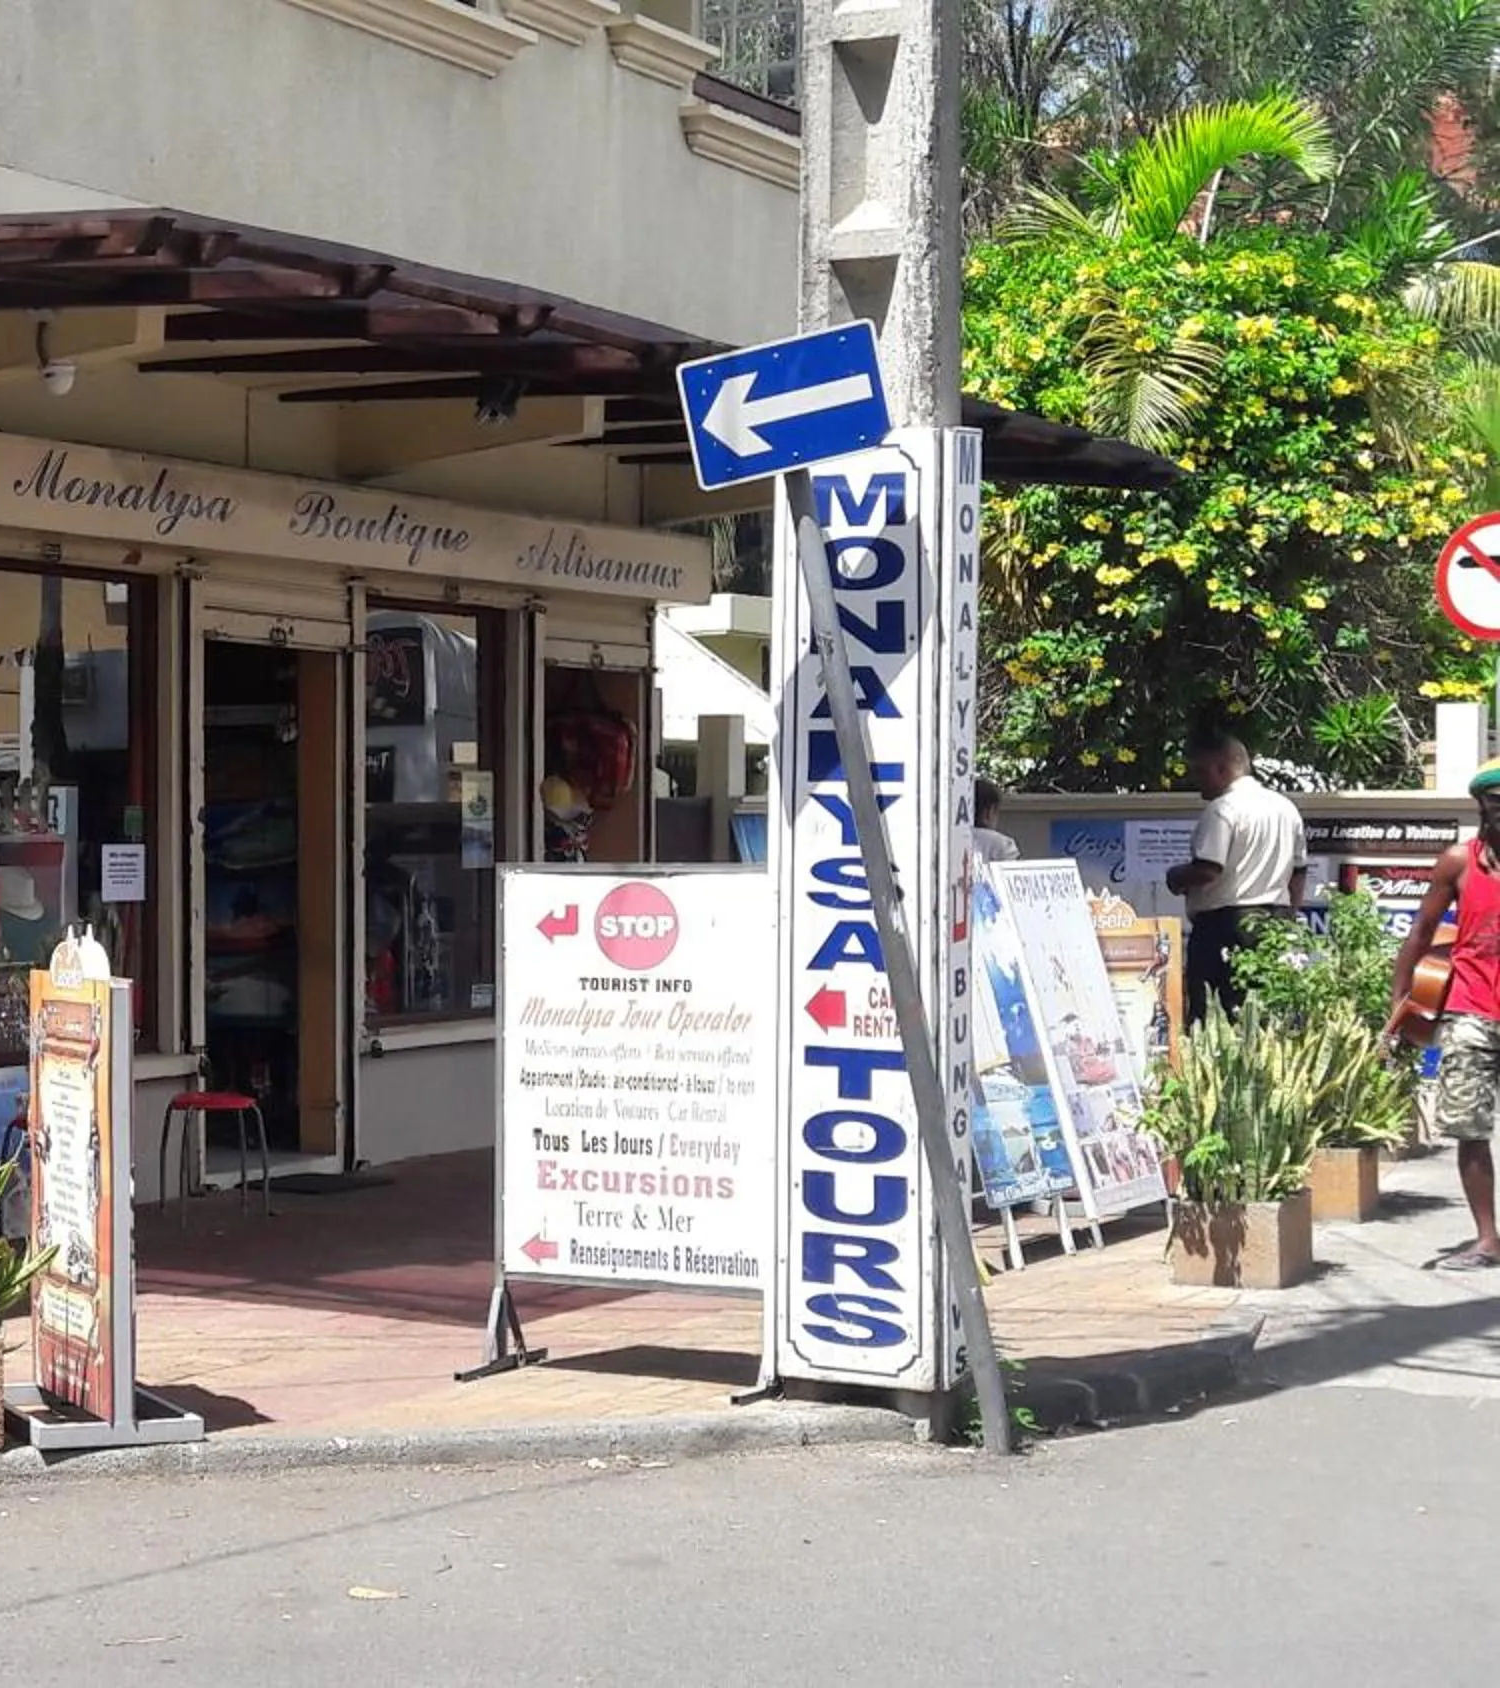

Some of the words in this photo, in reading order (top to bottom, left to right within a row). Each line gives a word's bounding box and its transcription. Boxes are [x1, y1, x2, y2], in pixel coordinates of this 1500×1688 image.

[13, 449, 233, 536] Monalysa
[289, 491, 472, 566] Boutique
[515, 528, 683, 590] Artisanaux
[954, 435, 976, 828] MONALYSA
[1332, 825, 1385, 840] Location
[1404, 824, 1457, 841] Voitures
[599, 915, 675, 940] STOP
[579, 977, 650, 993] TOURIST
[655, 977, 693, 993] INFO
[519, 997, 616, 1035] Monalysa
[619, 999, 663, 1029] Tour
[667, 998, 753, 1038] Operator
[544, 1097, 593, 1119] Location
[595, 1099, 609, 1119] de
[533, 1127, 570, 1153] Tous
[581, 1129, 607, 1154] Les
[613, 1130, 653, 1155] Jours
[669, 1132, 741, 1165] Everyday
[537, 1159, 735, 1200] Excursions
[802, 1045, 909, 1349] TOURS
[573, 1200, 623, 1229] Terre
[631, 1204, 648, 1230] &
[657, 1205, 695, 1233] Mer
[569, 1238, 669, 1273] Renseignements
[685, 1245, 760, 1278] Réservation
